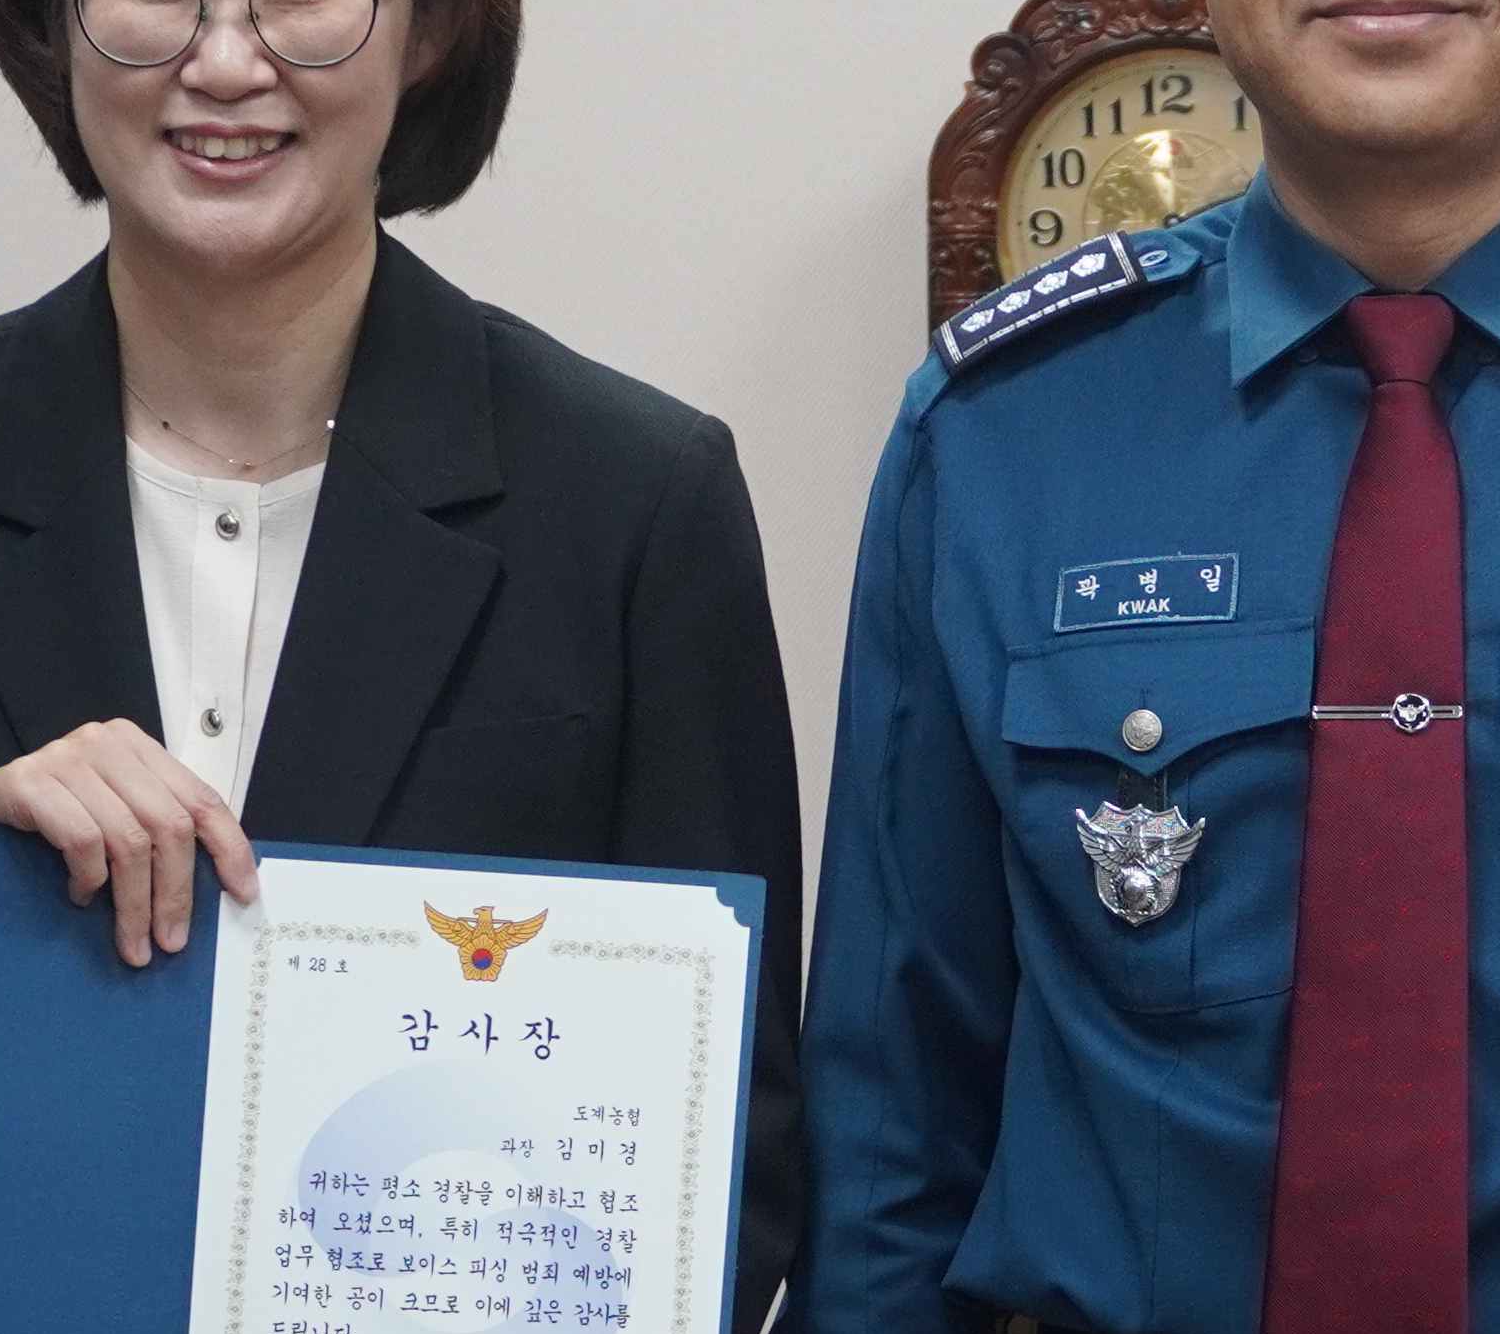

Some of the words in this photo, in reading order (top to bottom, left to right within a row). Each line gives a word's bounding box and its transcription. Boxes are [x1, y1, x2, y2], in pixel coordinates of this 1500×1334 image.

[1140, 74, 1195, 116] 12
[1082, 97, 1124, 138] 11
[1040, 148, 1086, 189] 10
[1029, 208, 1063, 247] 9
[1117, 597, 1171, 615] KWAK
[288, 954, 301, 972] 제
[308, 956, 327, 973] 28
[333, 958, 349, 974] 호
[400, 1009, 561, 1061] 감사장
[499, 1137, 535, 1159] 과장
[557, 1136, 637, 1166] 김미경
[308, 1170, 371, 1198] 귀하는
[380, 1174, 421, 1200] 평소
[433, 1178, 494, 1207] 경찰을
[505, 1183, 586, 1209] 이해하고
[599, 1189, 639, 1215] 협조
[278, 1205, 316, 1231] 하여
[332, 1210, 423, 1239] 오셨으며,
[439, 1216, 478, 1242] 특히
[497, 1220, 578, 1250] 적극적인
[596, 1226, 637, 1254] 경찰
[275, 1243, 315, 1268] 업무
[326, 1246, 386, 1272] 협조로
[397, 1253, 458, 1276] 보이스
[468, 1256, 507, 1284] 피싱
[521, 1260, 559, 1286] 범죄
[572, 1263, 632, 1291] 예방에
[272, 1281, 333, 1309] 기여한
[345, 1286, 385, 1311] 공이
[399, 1291, 460, 1314] 크므로
[475, 1294, 511, 1319] 이에
[524, 1298, 563, 1324] 깊은
[573, 1301, 631, 1329] 감사를
